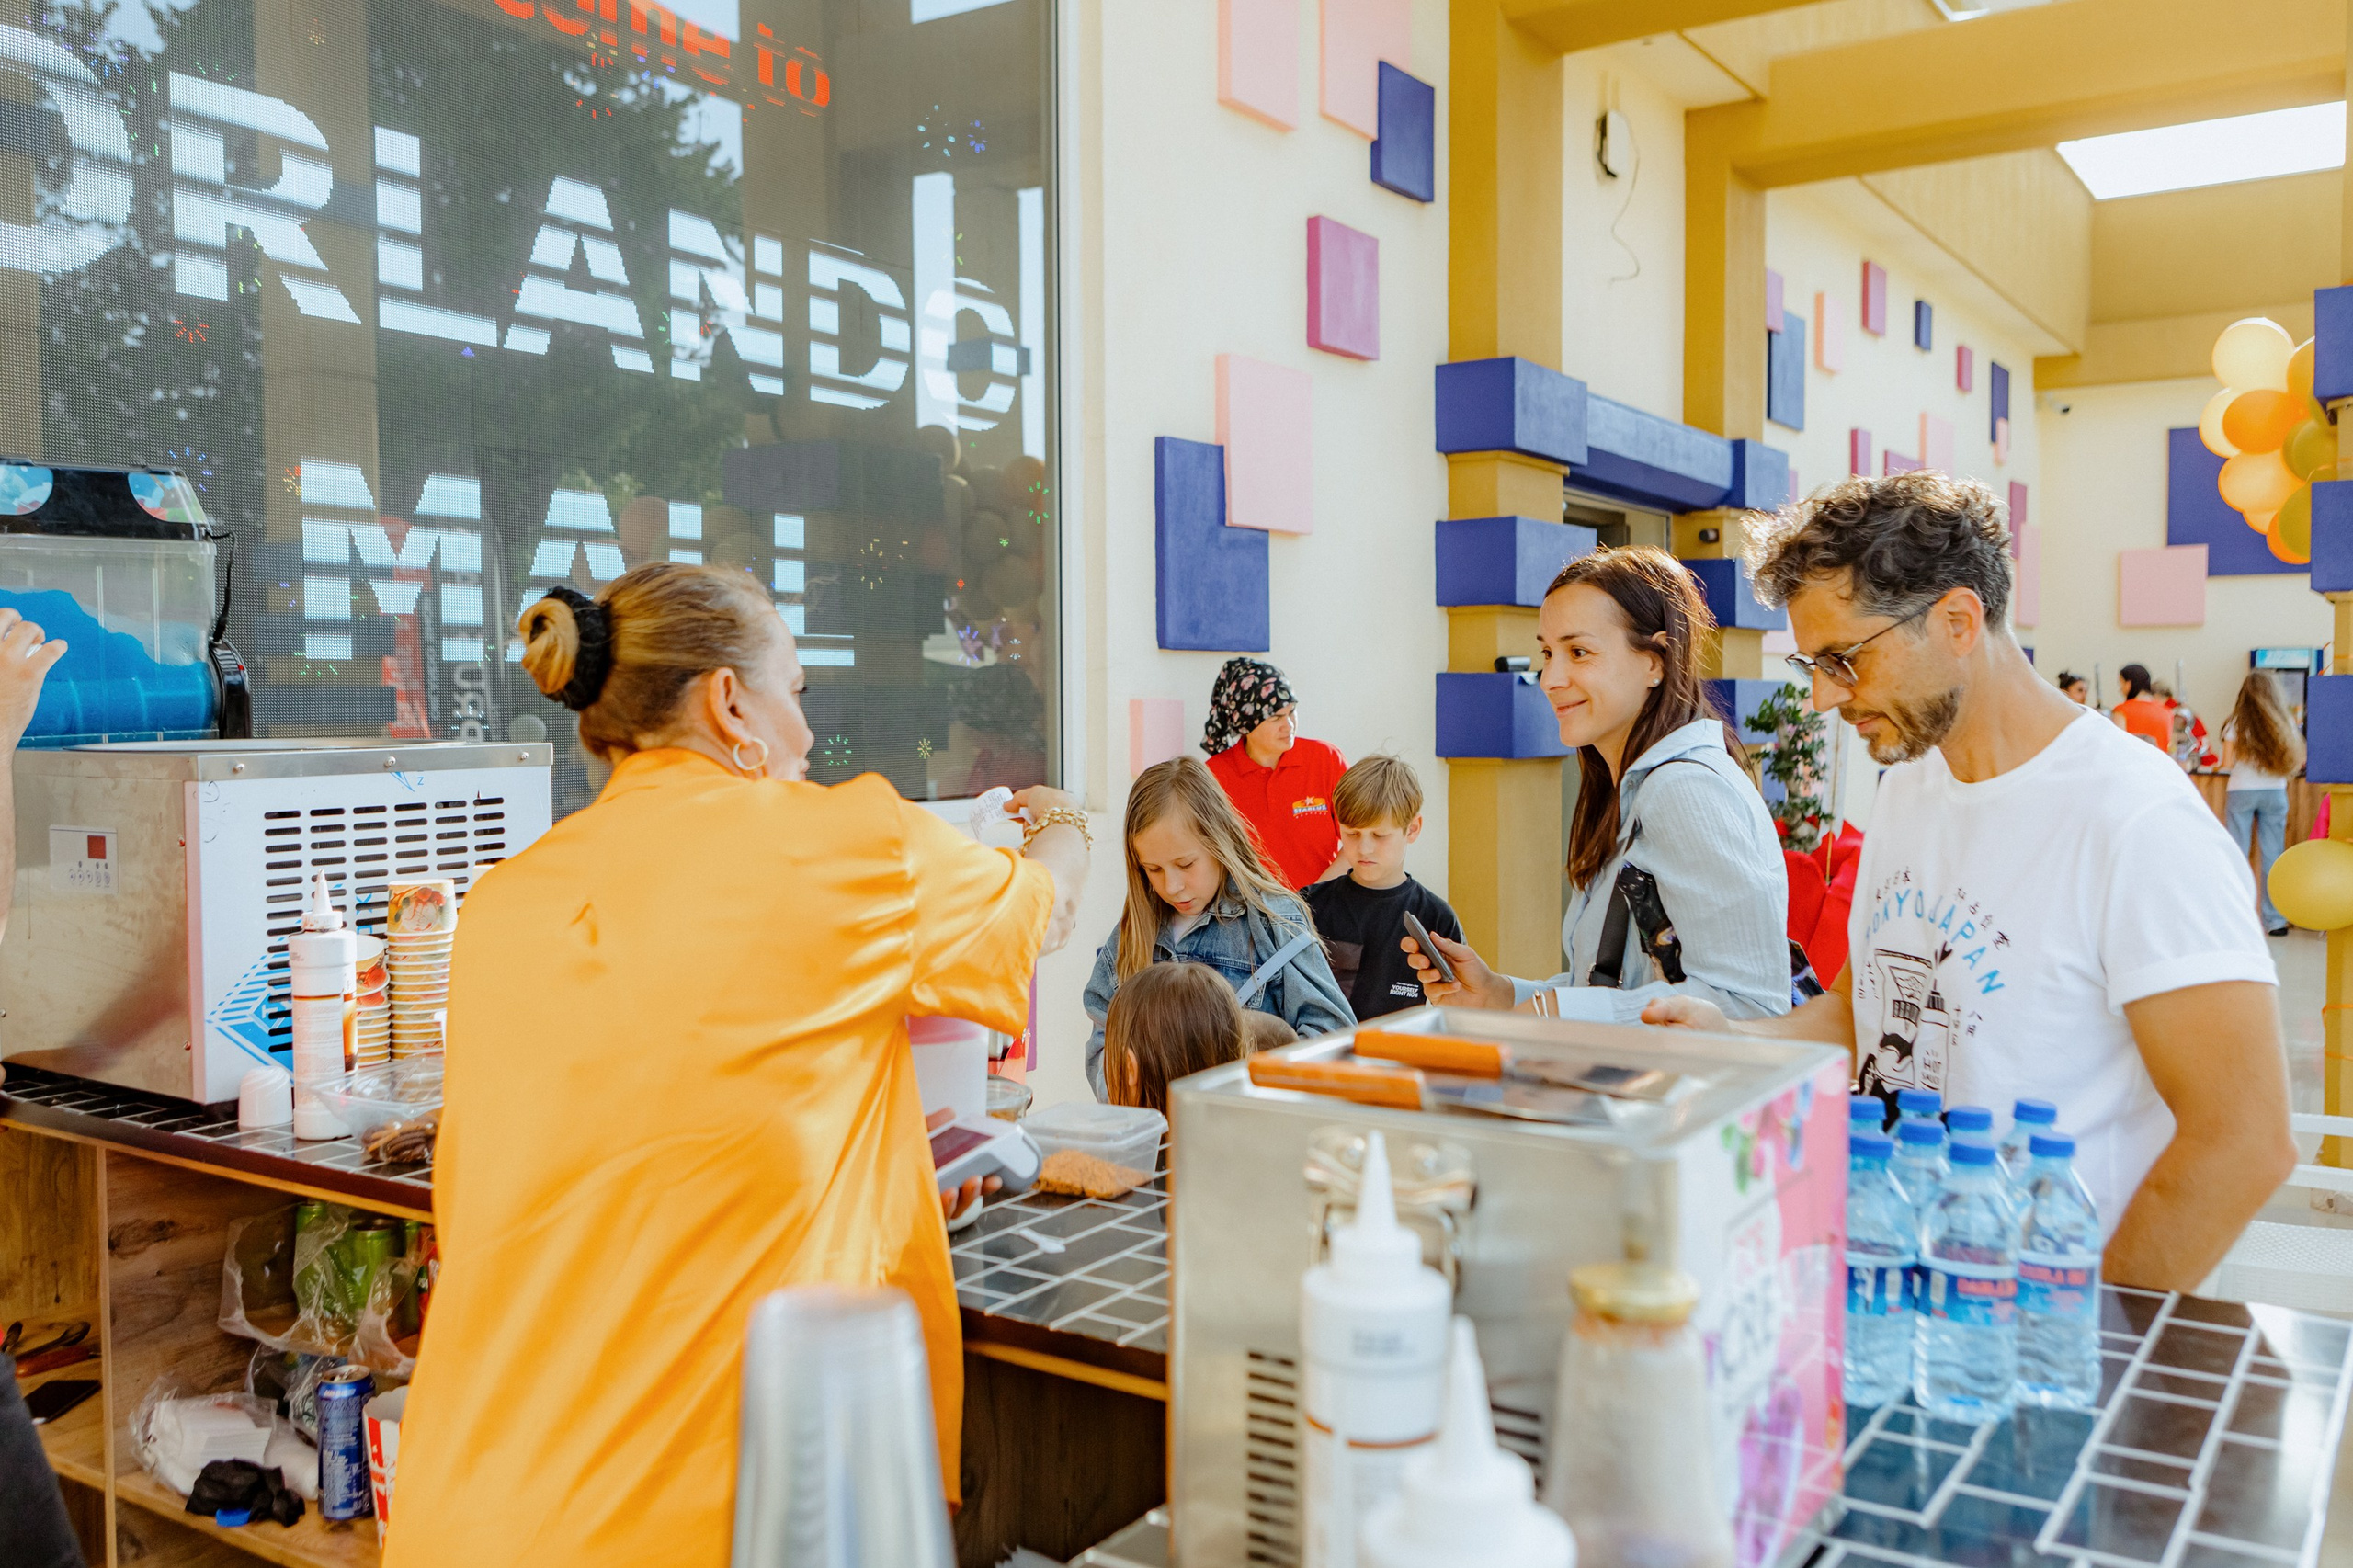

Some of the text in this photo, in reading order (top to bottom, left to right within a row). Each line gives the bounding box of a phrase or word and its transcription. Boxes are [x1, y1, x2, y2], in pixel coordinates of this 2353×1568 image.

[494, 0, 830, 117] ome to
[0, 24, 1017, 431] ORLANDO
[1392, 984, 1419, 993] YOURSELF
[1927, 894, 2006, 995] JAPAN
